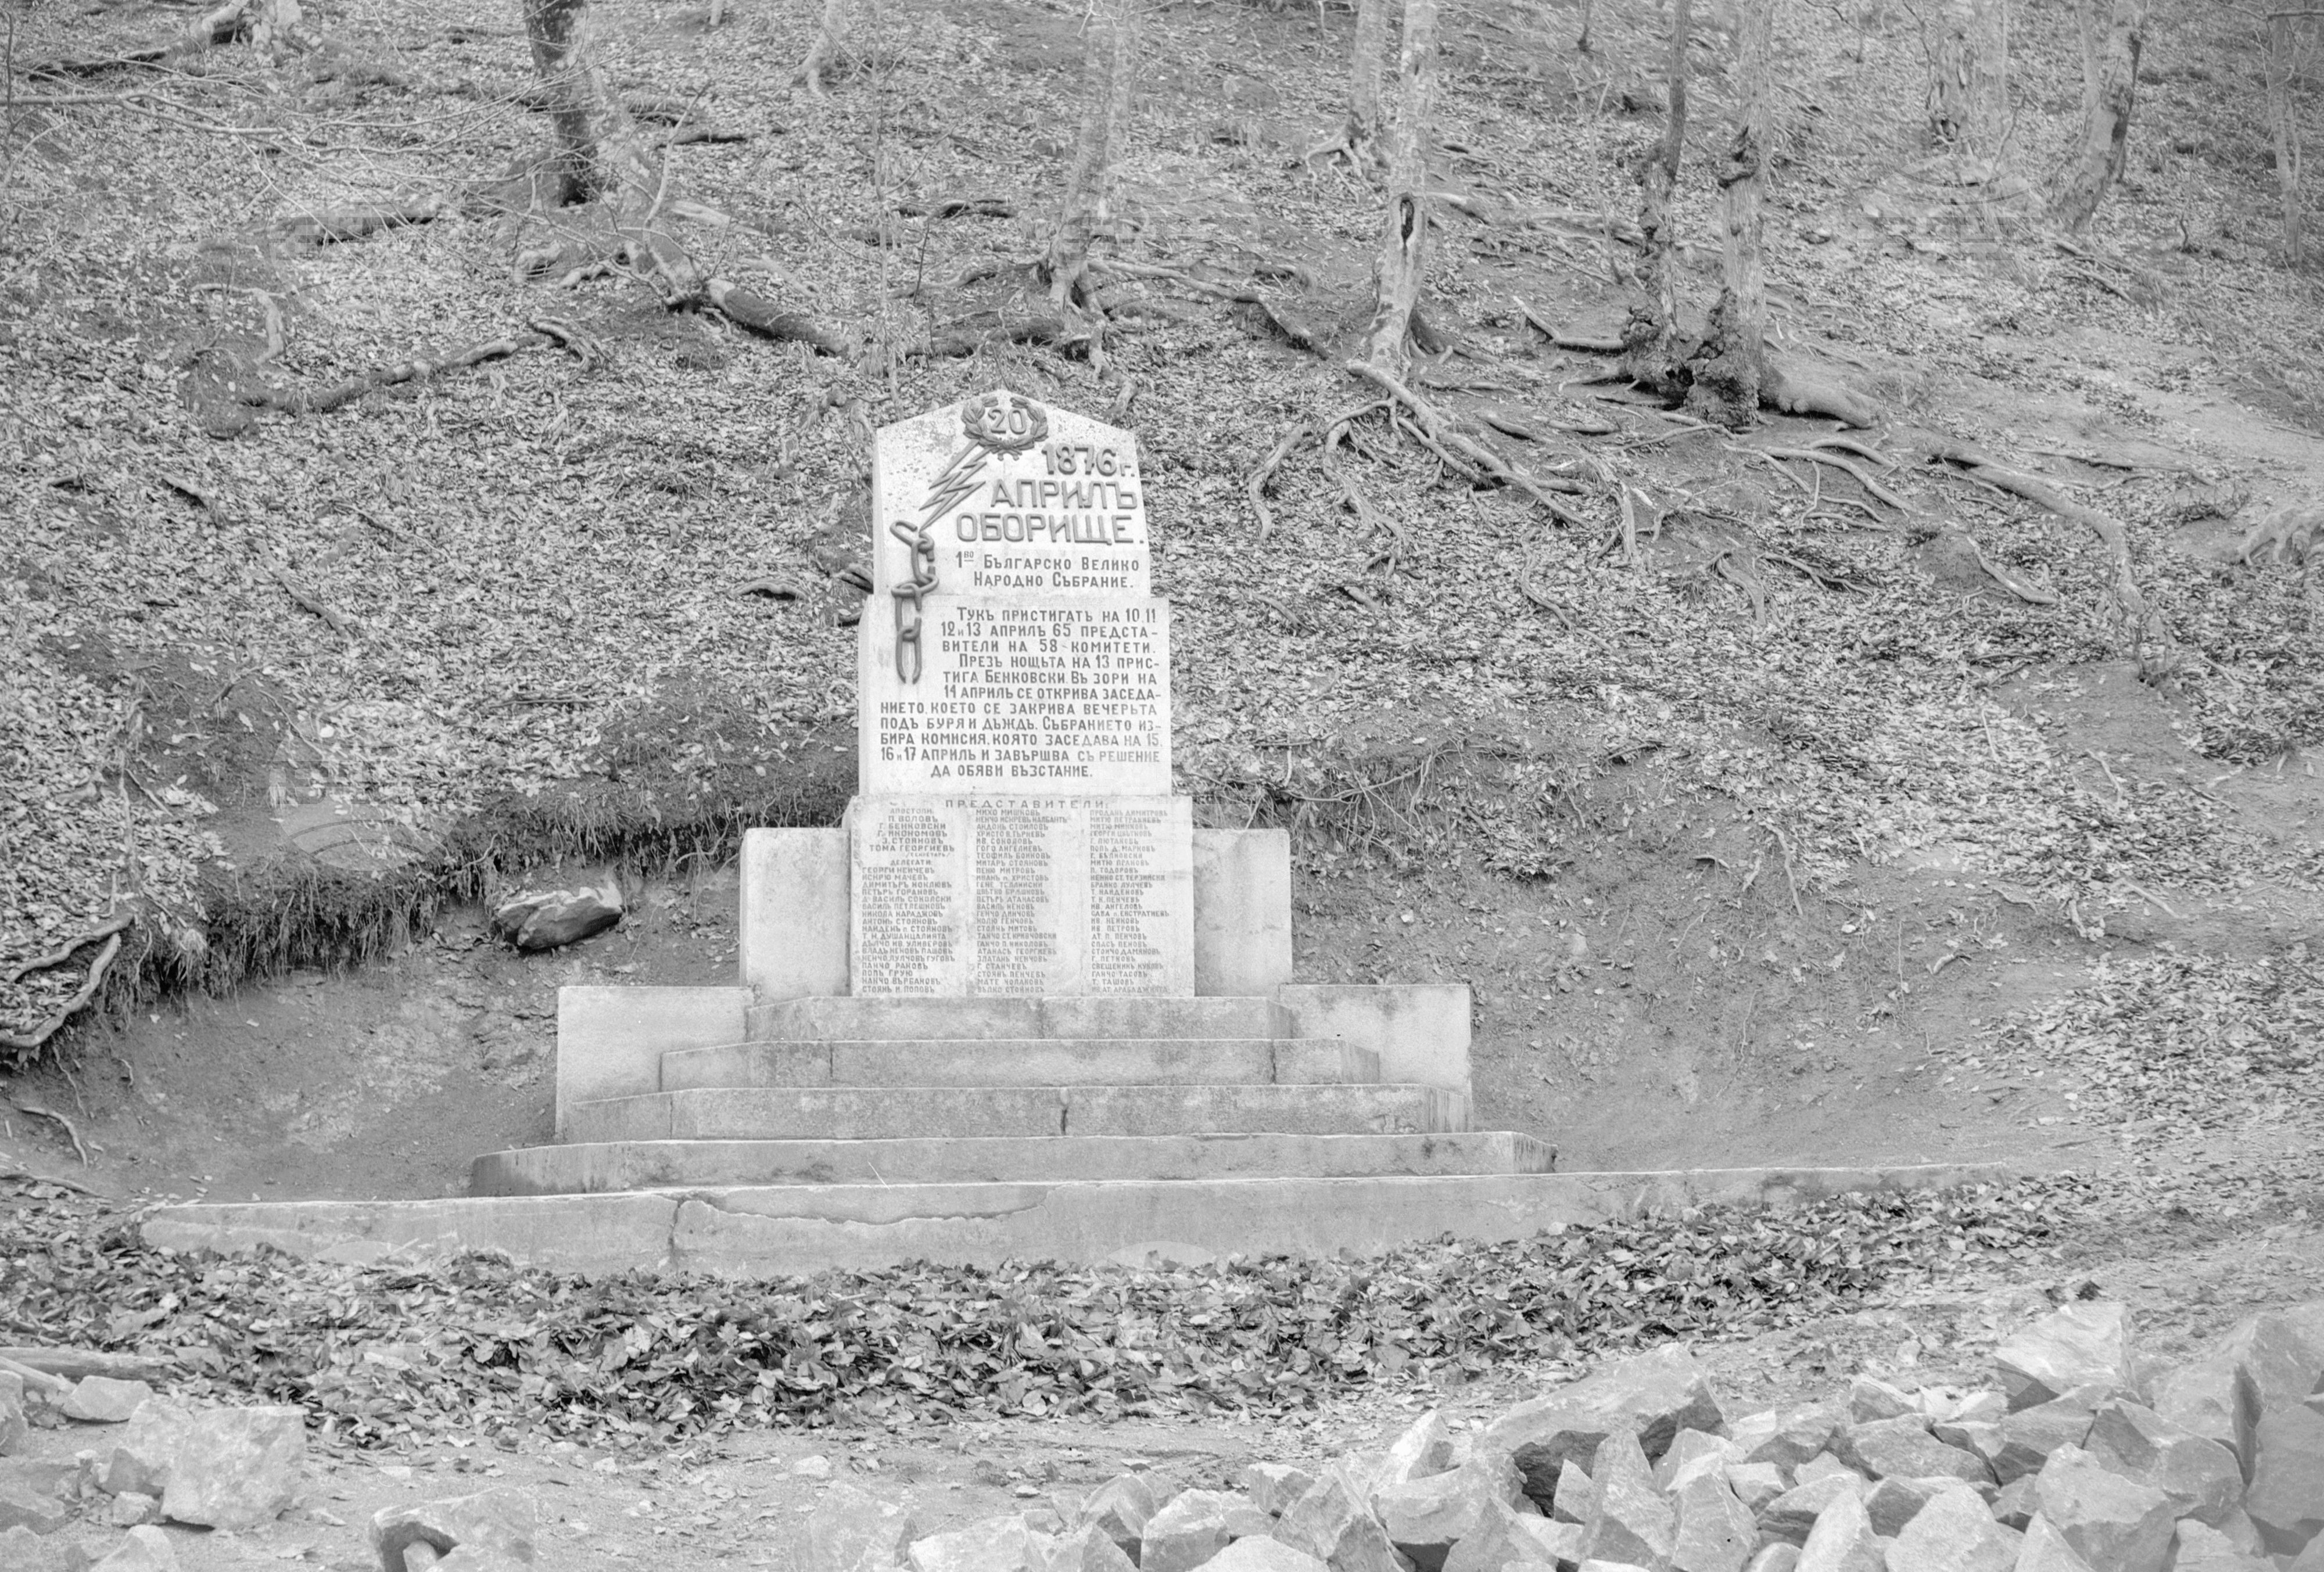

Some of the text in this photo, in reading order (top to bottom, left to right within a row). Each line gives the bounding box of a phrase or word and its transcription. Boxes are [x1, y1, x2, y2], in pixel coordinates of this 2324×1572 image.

[988, 408, 1026, 434] 20
[1041, 445, 1135, 477] 1876г.
[991, 479, 1137, 509] АПРИЛЪ
[956, 513, 1144, 544] ОБОРИЩЕ.
[1082, 557, 1139, 571] ВЕЛИКО
[974, 572, 1133, 588] НАРОДНО СЪБРАНИЕ.
[957, 606, 994, 621] ТУКЪ
[1002, 610, 1093, 622] ПРИСТИГАТЪ
[1103, 611, 1120, 622] НА
[941, 621, 955, 636] 12
[967, 622, 981, 637] 13
[990, 625, 1046, 637] АПРИЛЪ
[1053, 623, 1071, 637] 65
[942, 638, 1154, 653] ВИТЕЛИ НА 58 КОМИТЕТИ.
[959, 656, 1003, 668] ПРЕЗЪ
[1073, 657, 1091, 668] НА
[1096, 655, 1109, 668] 13
[1117, 658, 1159, 669] ПРИС-
[944, 672, 978, 683] ТИГА
[1071, 671, 1088, 684] ВЪ
[1093, 673, 1128, 684] ЗОРИ
[1138, 673, 1157, 684] НА
[944, 684, 956, 698] 14
[1017, 688, 1032, 699] СЕ
[1037, 688, 1098, 699] ОТКРИВА
[1103, 688, 1160, 701] ЗАСЕДА-
[931, 702, 975, 713] КОЕТО
[984, 703, 1000, 715] СЕ
[1010, 703, 1075, 715] ЗАКРИВА
[881, 717, 919, 730] ПОДЪ
[927, 718, 964, 729] БУРЯ
[969, 718, 976, 729] И
[1043, 716, 1131, 731] СЪБРАНИЕТО
[881, 733, 914, 744] БИРА
[993, 734, 1037, 745] КОЯТО
[1045, 734, 1118, 746] ЗАСЕДАВА
[1124, 735, 1141, 746] НА
[881, 746, 894, 760] 16
[904, 746, 916, 760] 17
[921, 749, 976, 760] АПРИЛЪ
[982, 749, 989, 760] И
[995, 749, 1069, 761] ЗАВЪРШВА
[1078, 751, 1094, 762] СЪ
[1099, 751, 1160, 762] РЕШЕНИЕ
[931, 765, 1092, 778] ДА ОБЯВИ ВЪЗСТАНИЕ.
